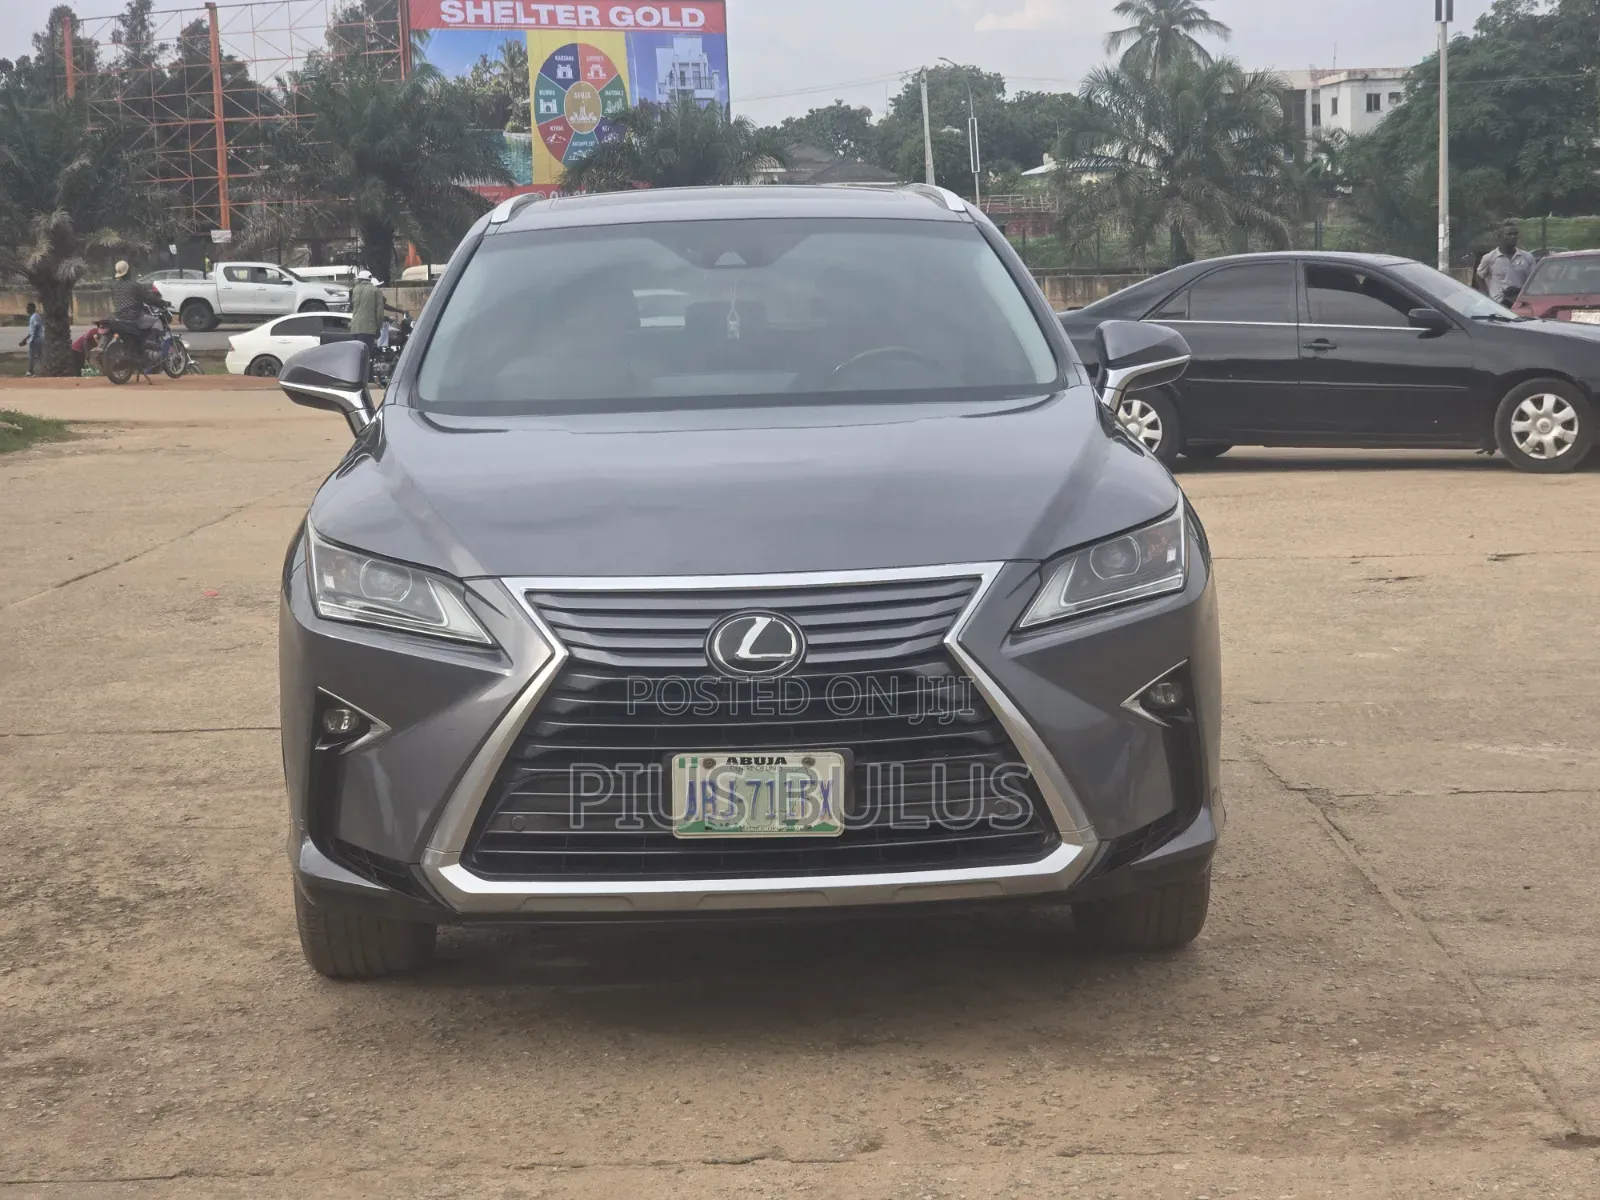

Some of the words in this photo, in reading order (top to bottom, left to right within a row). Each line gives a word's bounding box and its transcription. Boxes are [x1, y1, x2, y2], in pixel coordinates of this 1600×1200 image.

[440, 1, 600, 26] SHELTER
[608, 6, 706, 27] GOLD
[725, 756, 788, 765] ABUJA
